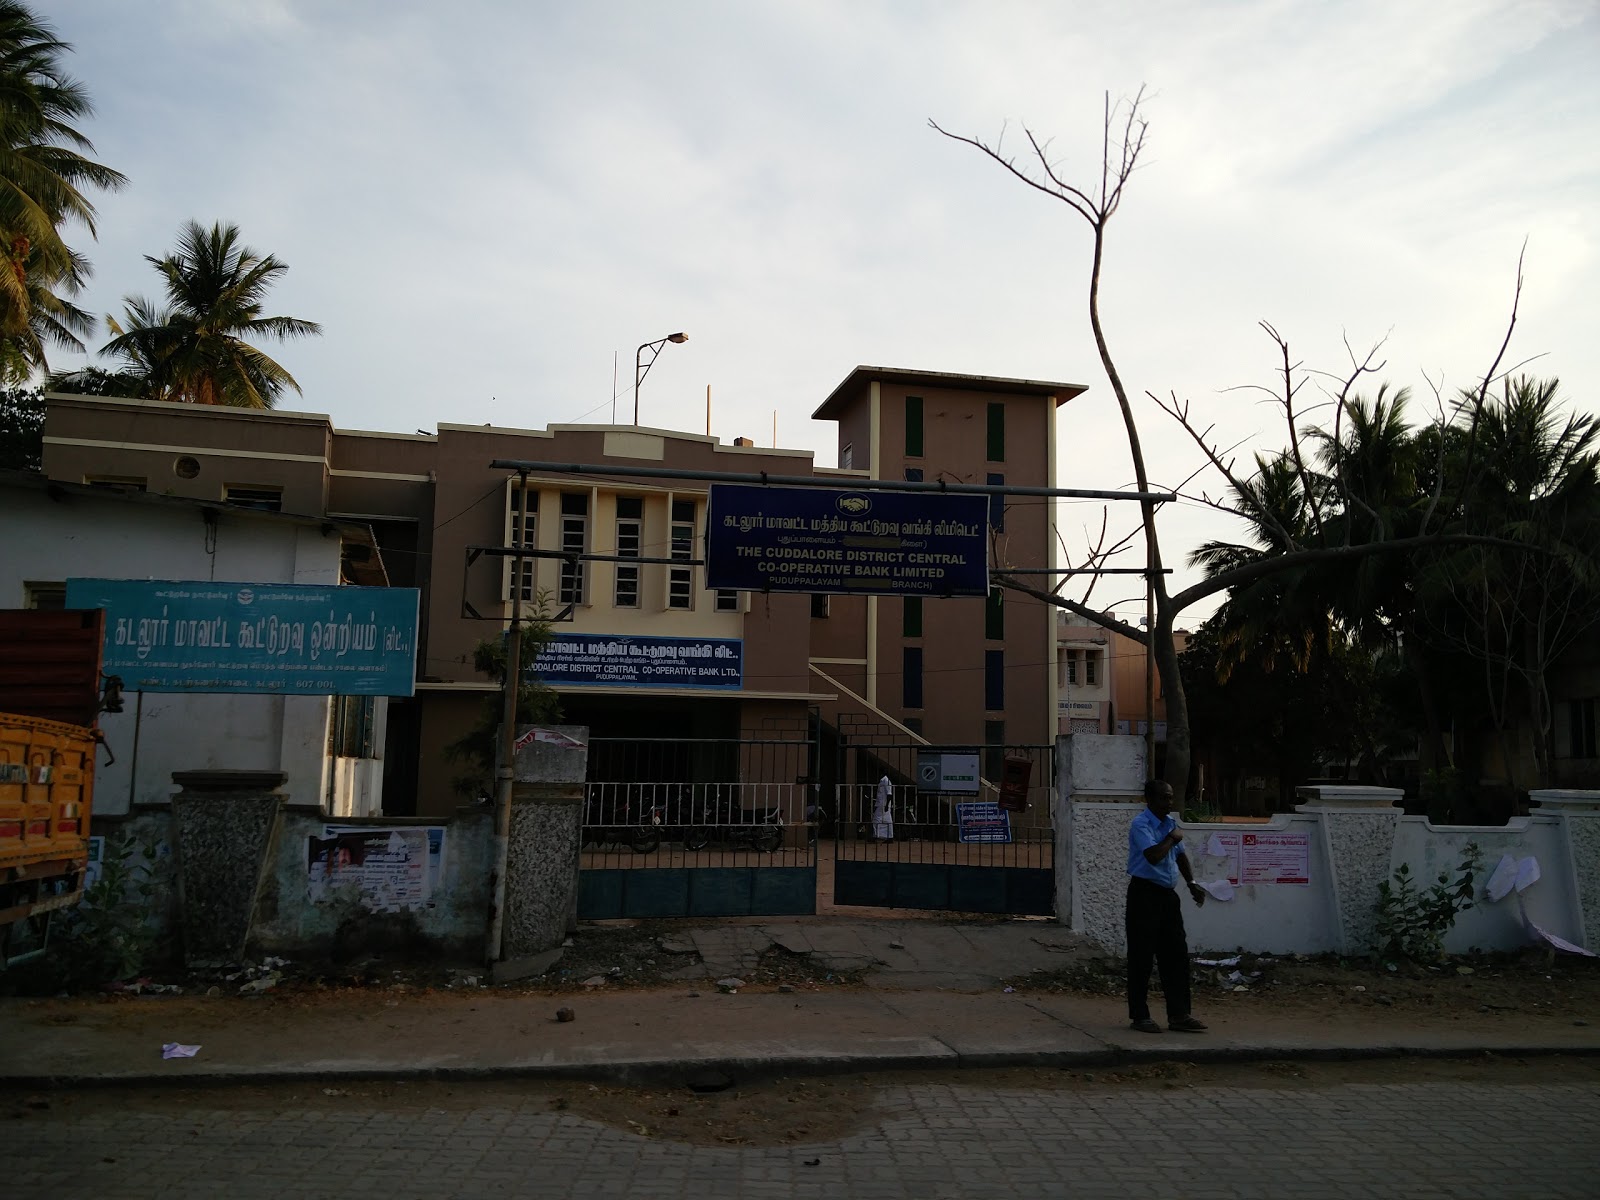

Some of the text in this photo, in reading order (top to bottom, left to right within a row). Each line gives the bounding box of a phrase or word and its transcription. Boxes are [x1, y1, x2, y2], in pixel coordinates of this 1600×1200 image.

[723, 511, 980, 537] கடலூர் மாவட்ட மத்திய கூட்டுறவு வங்கி லிமிடெட்
[777, 534, 836, 545] புதுப்பாளையம்
[736, 546, 967, 565] THE CUDDALORE DISTRICT CENTRAL
[757, 561, 945, 578] CO-OPERATIVE BANK LIMITED
[769, 576, 841, 586] PUDUPPALAYAM
[892, 580, 933, 590] BRANCH)
[115, 604, 170, 659] கடலூர்
[174, 615, 232, 648] மாவட்ட
[238, 614, 305, 657] கூட்டுறவு
[311, 609, 378, 661] ஒன்றியம்
[546, 641, 587, 654] மாவட்ட
[588, 641, 628, 656] மத்திய
[629, 644, 677, 659] கூட்டுறவு
[678, 643, 712, 658] வங்கி
[569, 663, 601, 673] DISTRICT
[603, 664, 639, 674] CENTRAL
[642, 666, 697, 676] CO-OPERATIVE
[698, 667, 720, 676] BANK
[296, 680, 314, 689] 607
